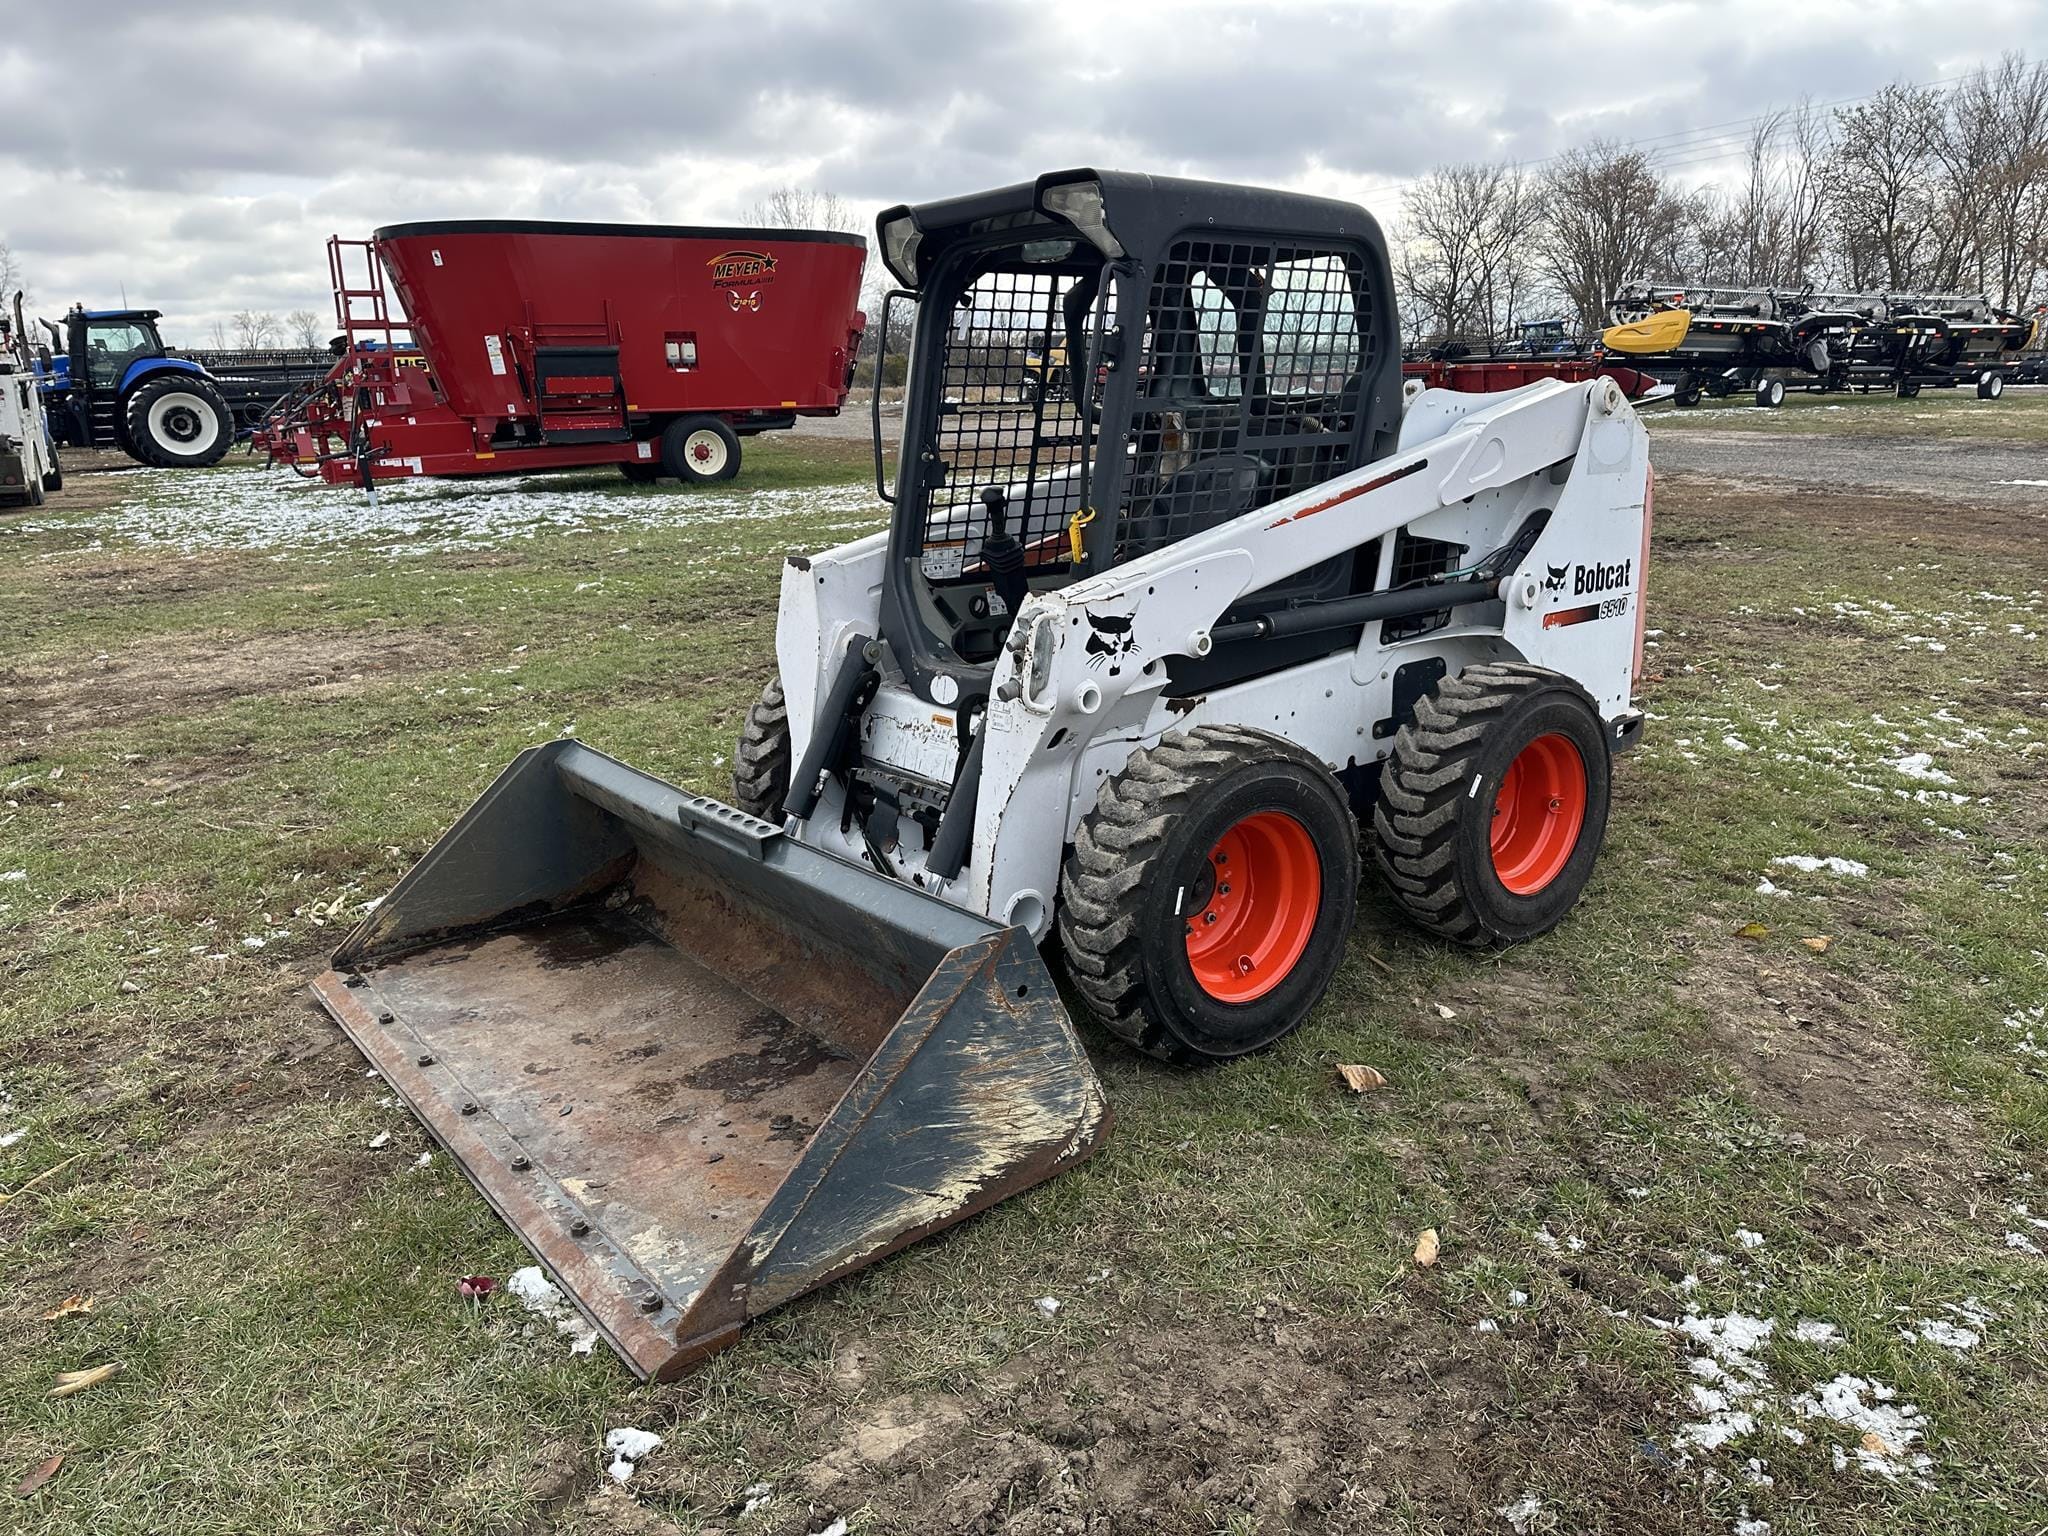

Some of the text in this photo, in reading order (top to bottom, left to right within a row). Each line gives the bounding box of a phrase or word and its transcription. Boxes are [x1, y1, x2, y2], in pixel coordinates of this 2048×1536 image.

[713, 261, 761, 279] MEYER
[1574, 558, 1631, 596] Bobcat
[1600, 597, 1628, 619] S510
